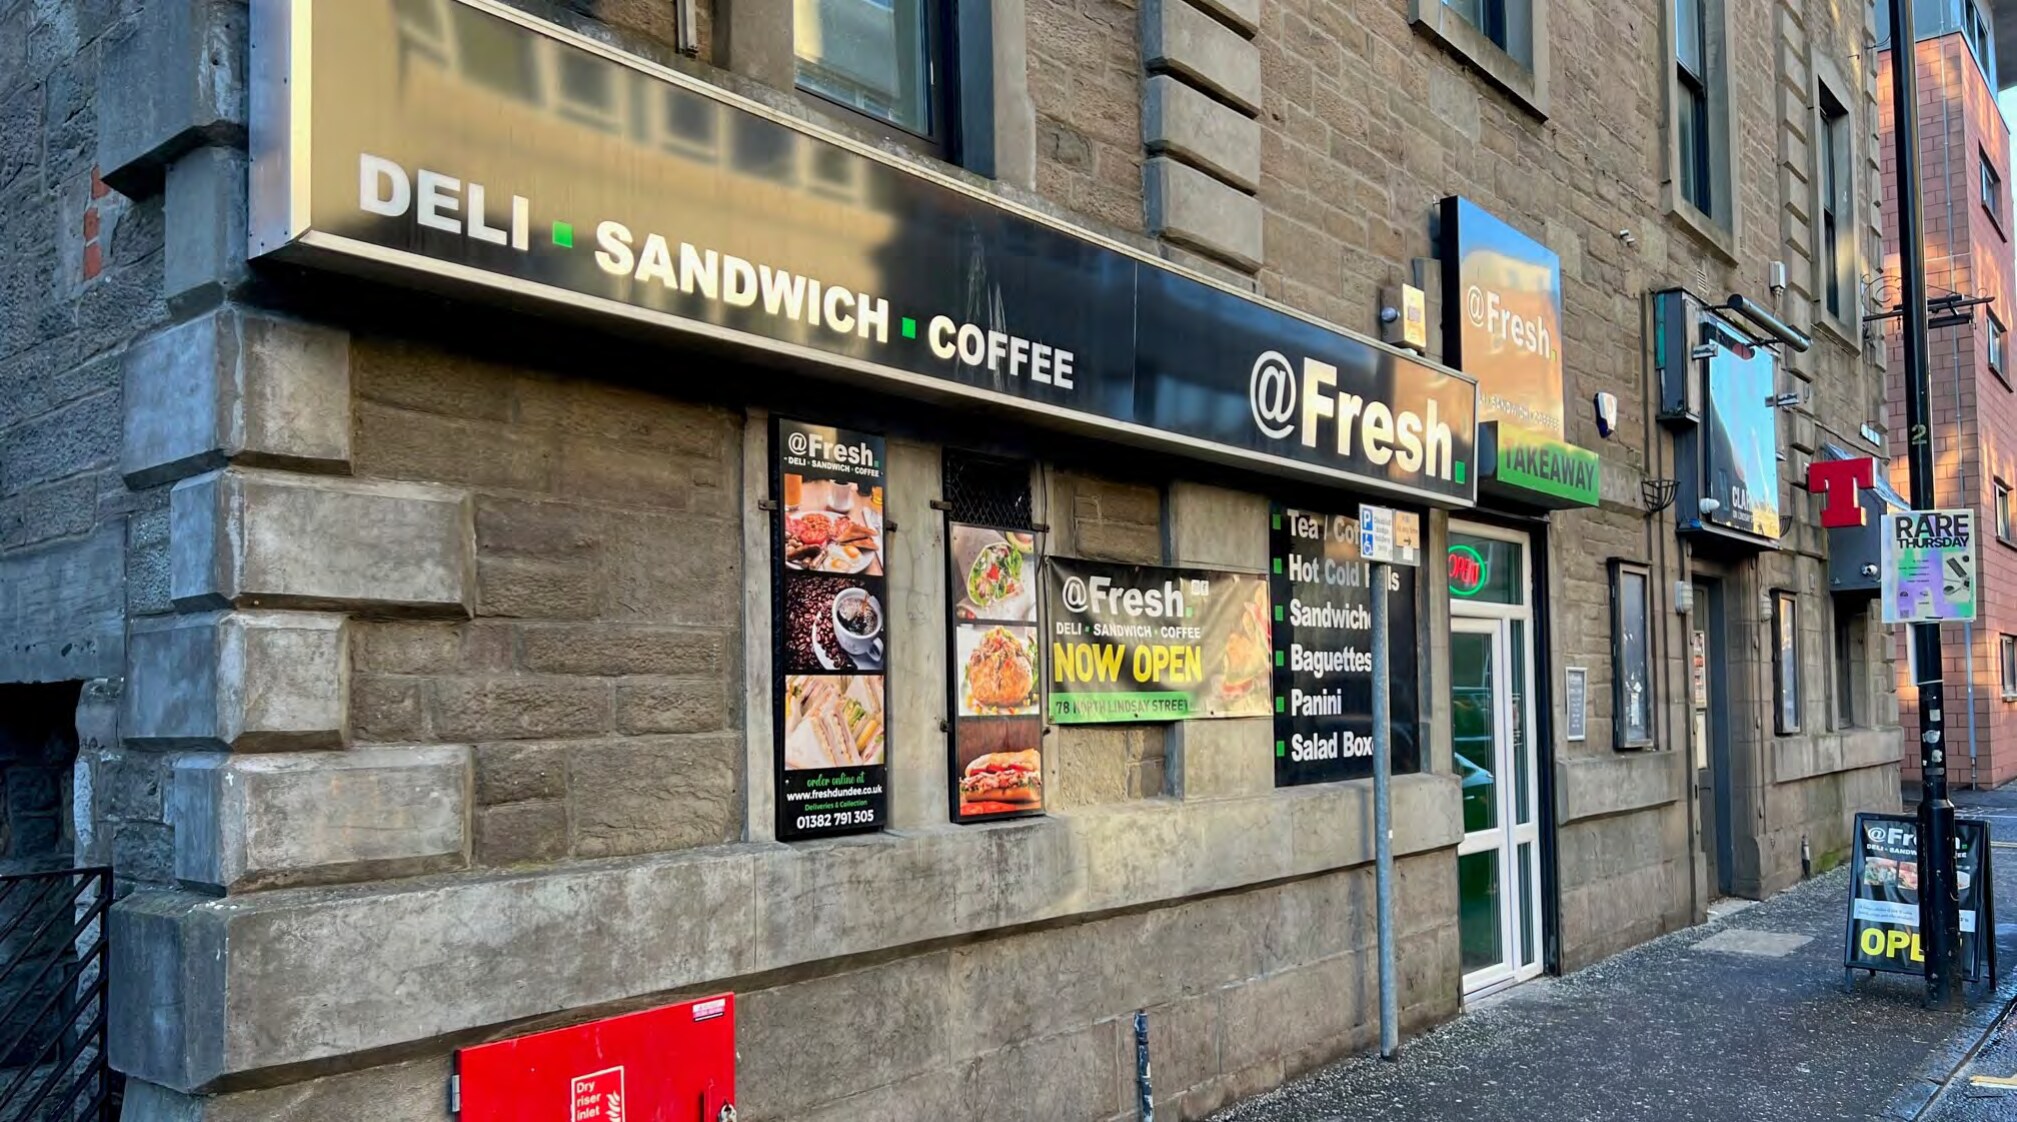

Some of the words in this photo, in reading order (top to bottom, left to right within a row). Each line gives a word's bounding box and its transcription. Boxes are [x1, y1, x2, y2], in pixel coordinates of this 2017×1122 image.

[360, 153, 529, 251] DELI
[594, 220, 889, 343] SANDWICH
[928, 315, 1074, 390] COFFEE
[1911, 424, 1928, 445] 2
[788, 457, 806, 466] DELI
[812, 460, 850, 472] SANDWICH
[854, 467, 880, 477] COFFEE
[1504, 440, 1595, 492] TAKEAWAY
[1808, 457, 1876, 528] T
[1287, 508, 1319, 539] Tea
[1333, 515, 1360, 545] Cof
[1895, 514, 1969, 538] RARE
[1896, 536, 1970, 549] THURSDAY
[1288, 553, 1320, 583] Hot
[1324, 558, 1360, 587] Cold
[1448, 553, 1480, 587] OPEN
[1290, 598, 1372, 629] Sandwich
[1056, 622, 1081, 635] DELI
[1093, 623, 1152, 638] SANDWICH
[1161, 626, 1201, 639] COFFEE
[1053, 642, 1126, 682] NOW
[1133, 644, 1203, 682] OPEN
[1290, 643, 1372, 678] Baguettes
[1056, 701, 1070, 714] 78
[1108, 700, 1150, 713] LINDSAY
[1291, 688, 1342, 716] Panini
[1291, 732, 1338, 762] Salad
[1343, 731, 1374, 757] Box
[807, 773, 830, 787] order
[832, 772, 855, 786] online
[857, 772, 865, 783] at
[787, 785, 882, 801] www.freshdundee.co.uk
[796, 813, 832, 829] 01382
[834, 811, 852, 826] 791
[854, 809, 874, 823] 305
[1866, 843, 1884, 852] DELI
[1889, 847, 1918, 856] SANDW
[576, 1081, 596, 1093] Dry
[577, 1093, 601, 1108] riser
[577, 1105, 600, 1121] inlet
